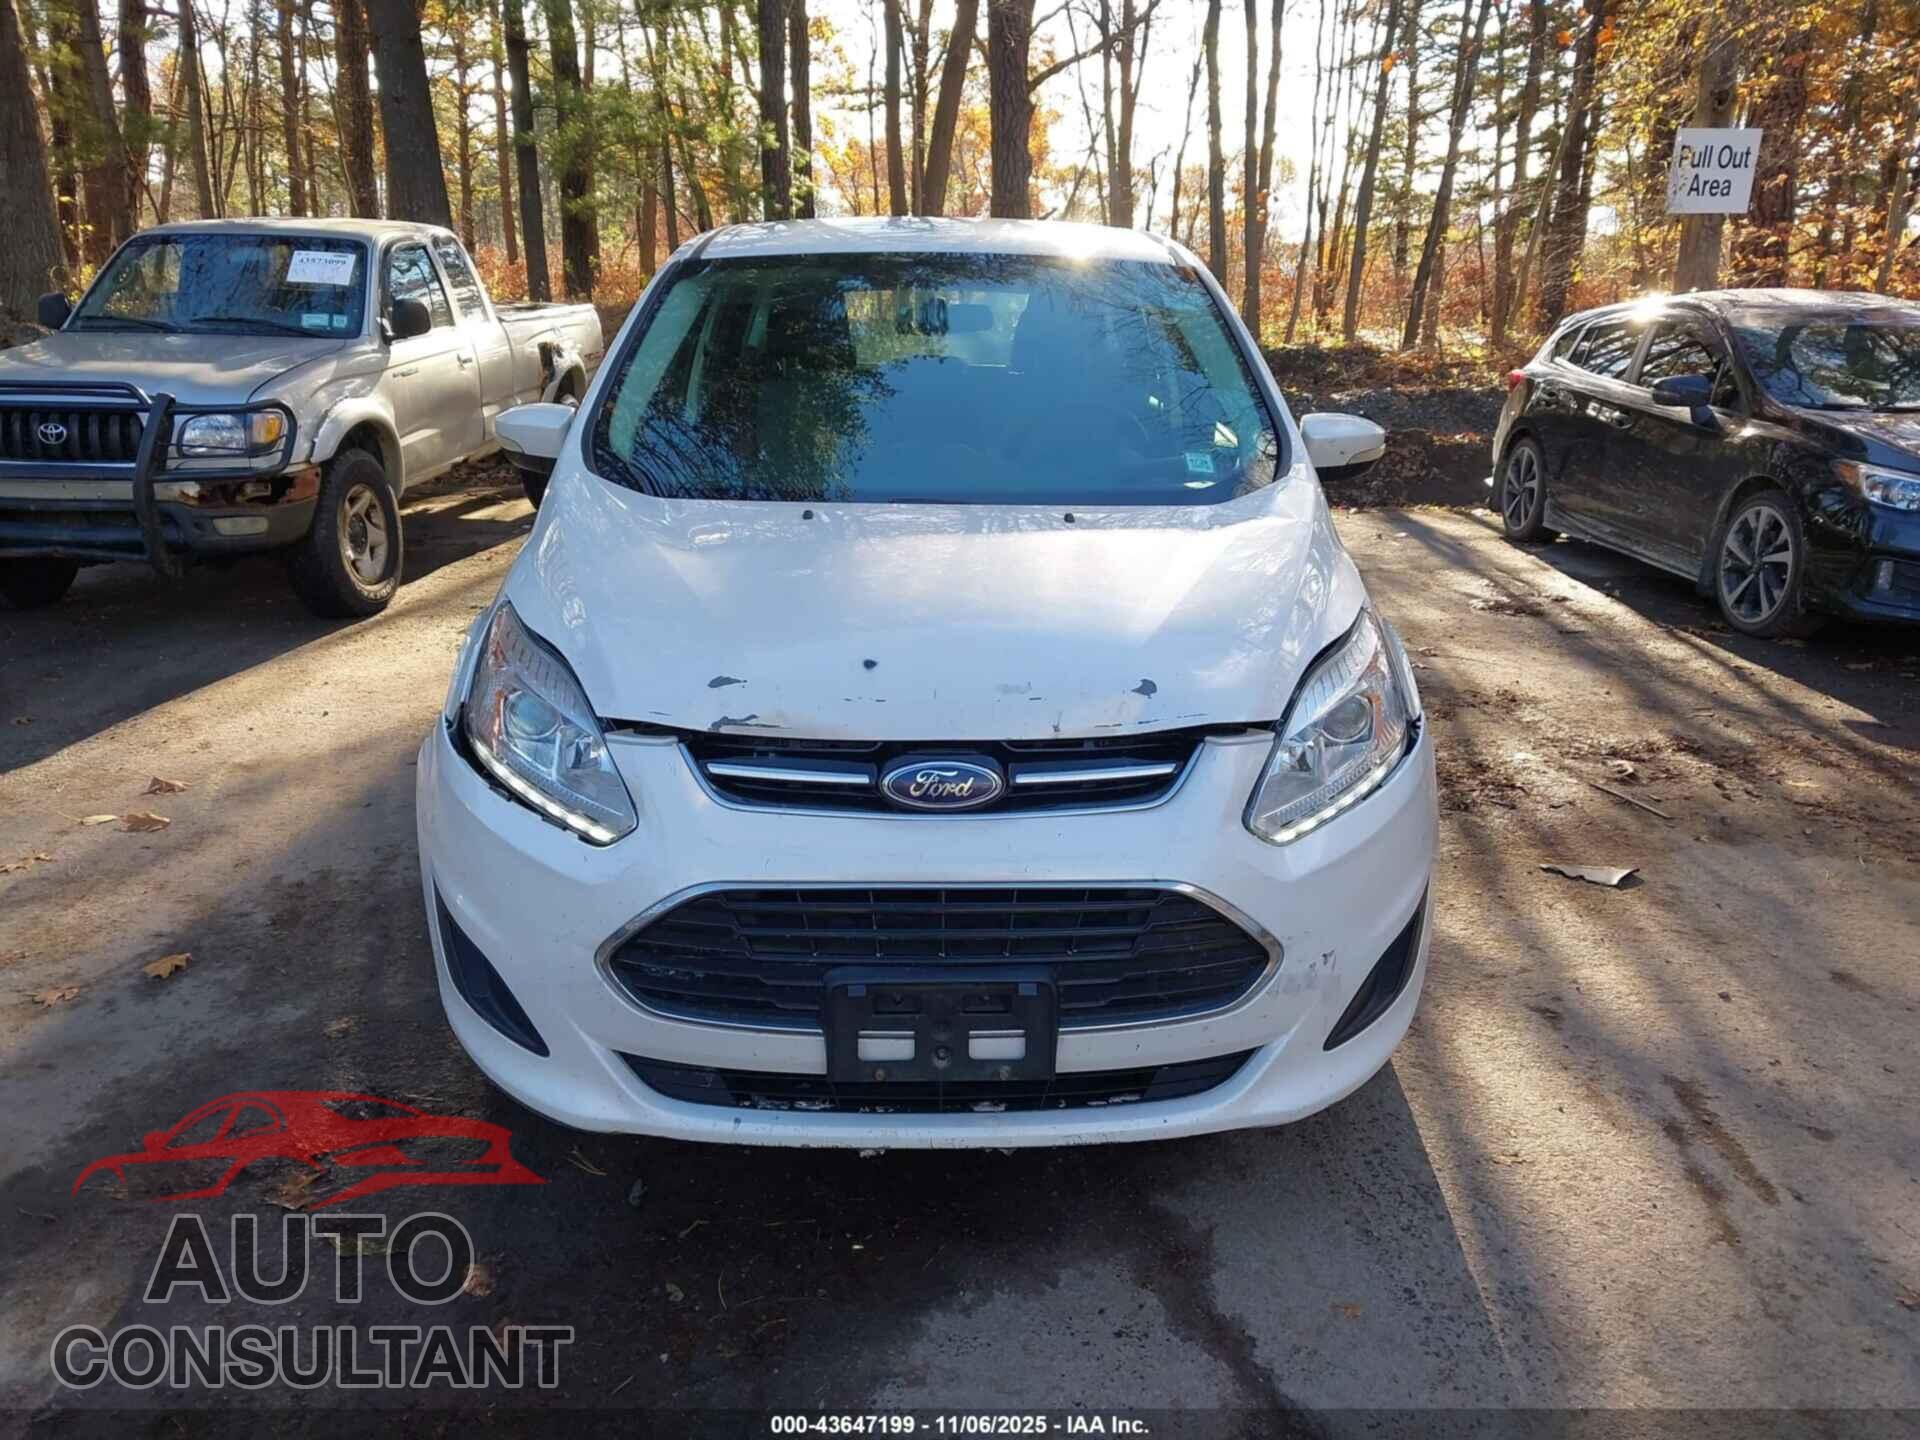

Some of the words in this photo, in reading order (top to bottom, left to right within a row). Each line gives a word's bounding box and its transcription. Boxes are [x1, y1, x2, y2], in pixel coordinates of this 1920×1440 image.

[1718, 144, 1751, 168] Out
[1687, 174, 1731, 196] Area
[910, 769, 974, 797] Ford
